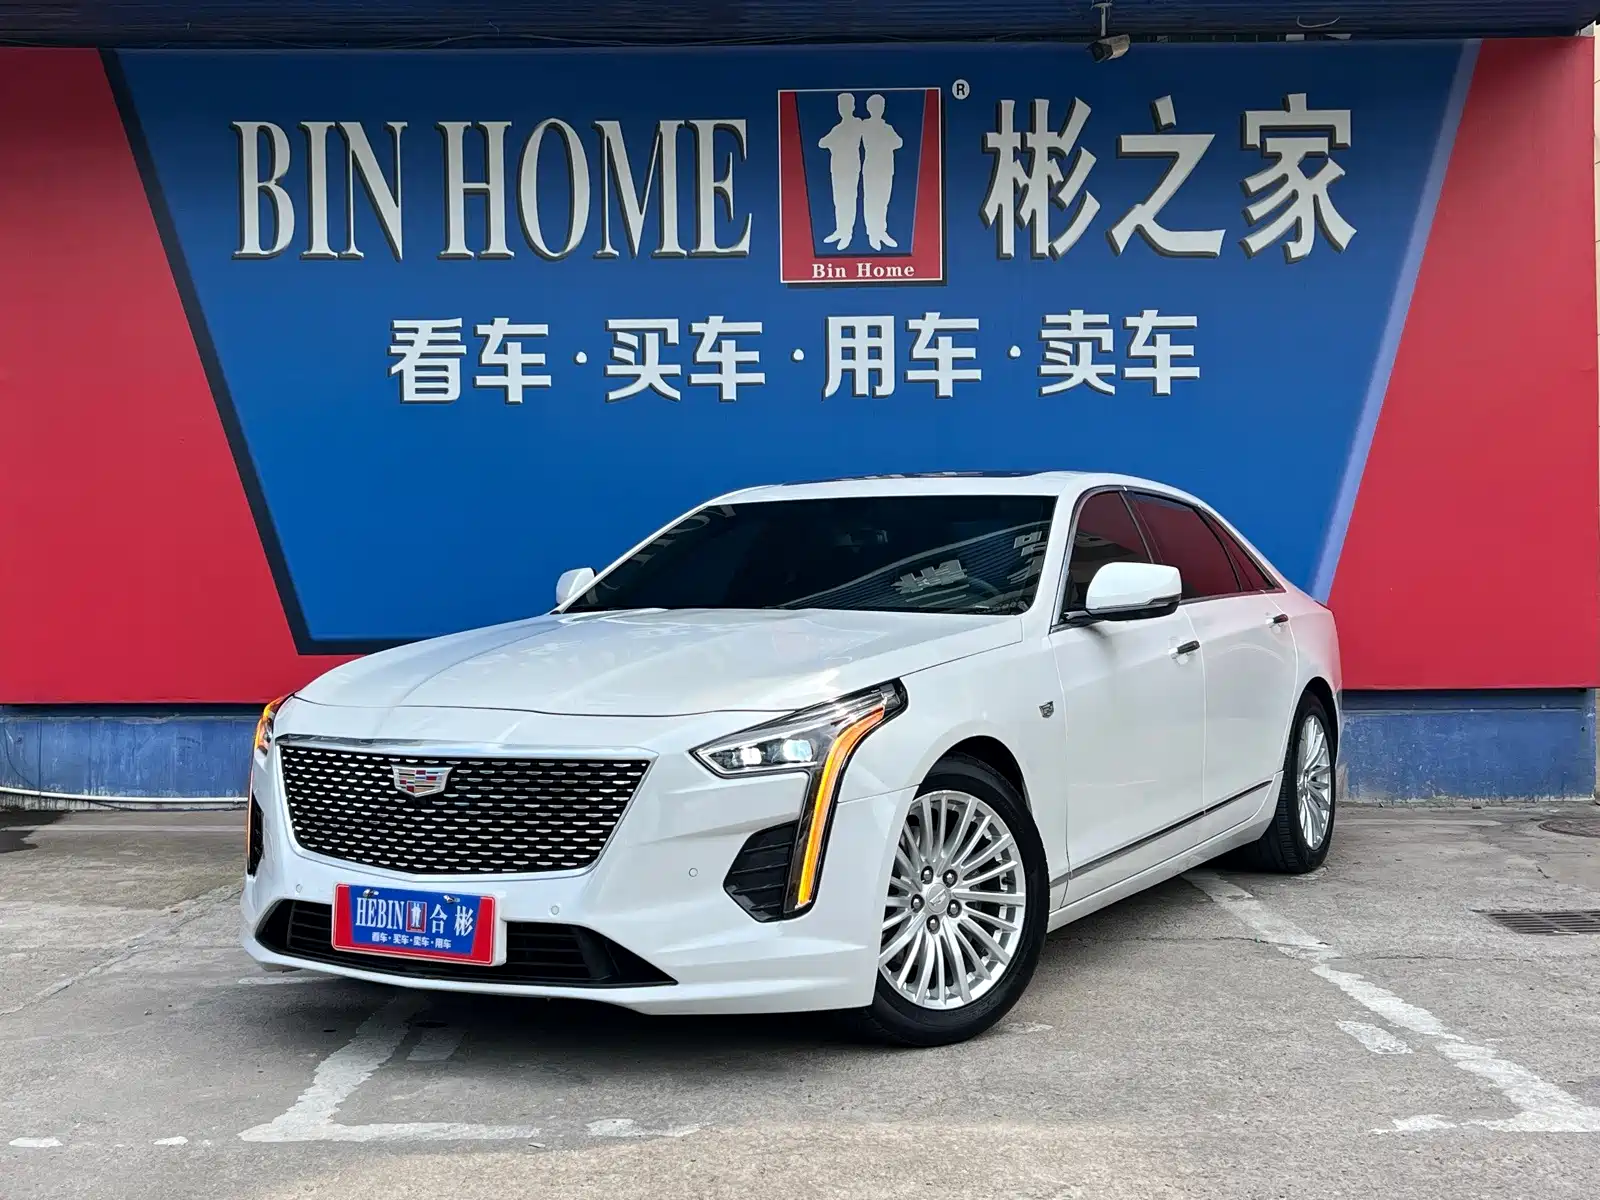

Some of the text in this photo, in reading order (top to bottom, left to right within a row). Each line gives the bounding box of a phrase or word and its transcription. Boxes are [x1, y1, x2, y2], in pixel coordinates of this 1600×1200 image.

[231, 118, 754, 260] BIN HOME
[981, 93, 1357, 261] 彬之家
[812, 262, 915, 278] Bin Home
[355, 897, 405, 930] HEBIN
[429, 903, 474, 937] 合彬
